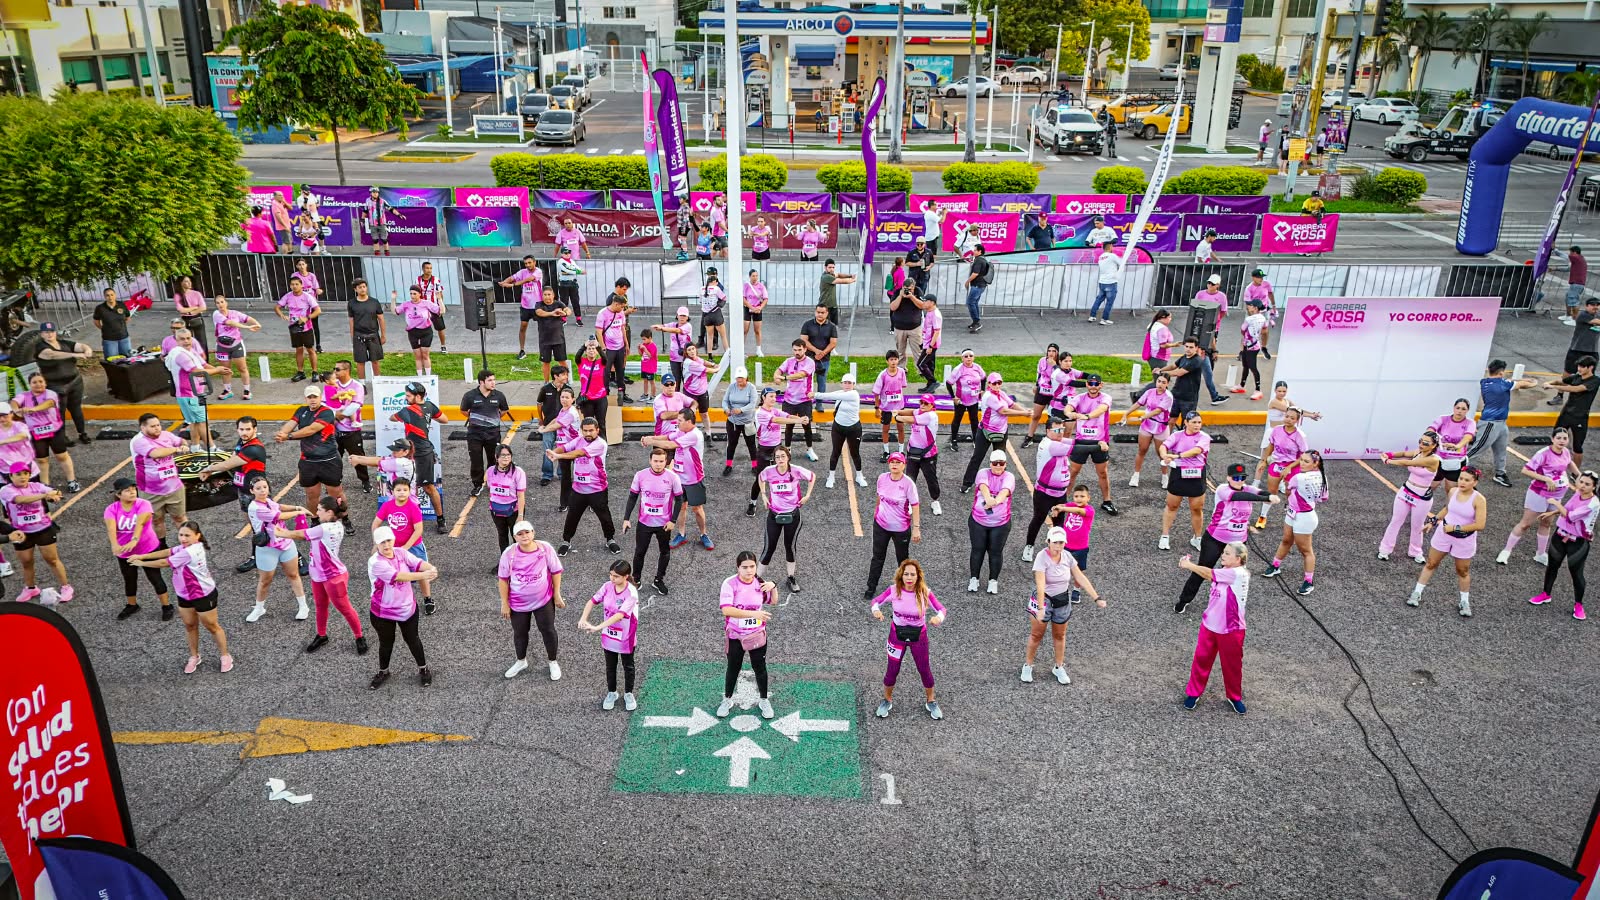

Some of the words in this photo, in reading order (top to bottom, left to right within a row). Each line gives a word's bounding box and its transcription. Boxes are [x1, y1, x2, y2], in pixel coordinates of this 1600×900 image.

[785, 18, 825, 31] ARCO
[770, 200, 822, 211] VIBRA
[991, 203, 1042, 211] VIBRA
[876, 222, 923, 232] VIBRA
[876, 232, 913, 243] 96.9
[1291, 230, 1327, 239] ROSA
[1323, 303, 1367, 311] CARRERA
[1322, 310, 1366, 323] ROSA
[1389, 313, 1405, 322] YO
[1406, 313, 1448, 322] CORRO
[1450, 313, 1483, 322] POR...
[744, 617, 757, 625] 783
[6, 683, 46, 737] Con
[879, 773, 903, 805] 1
